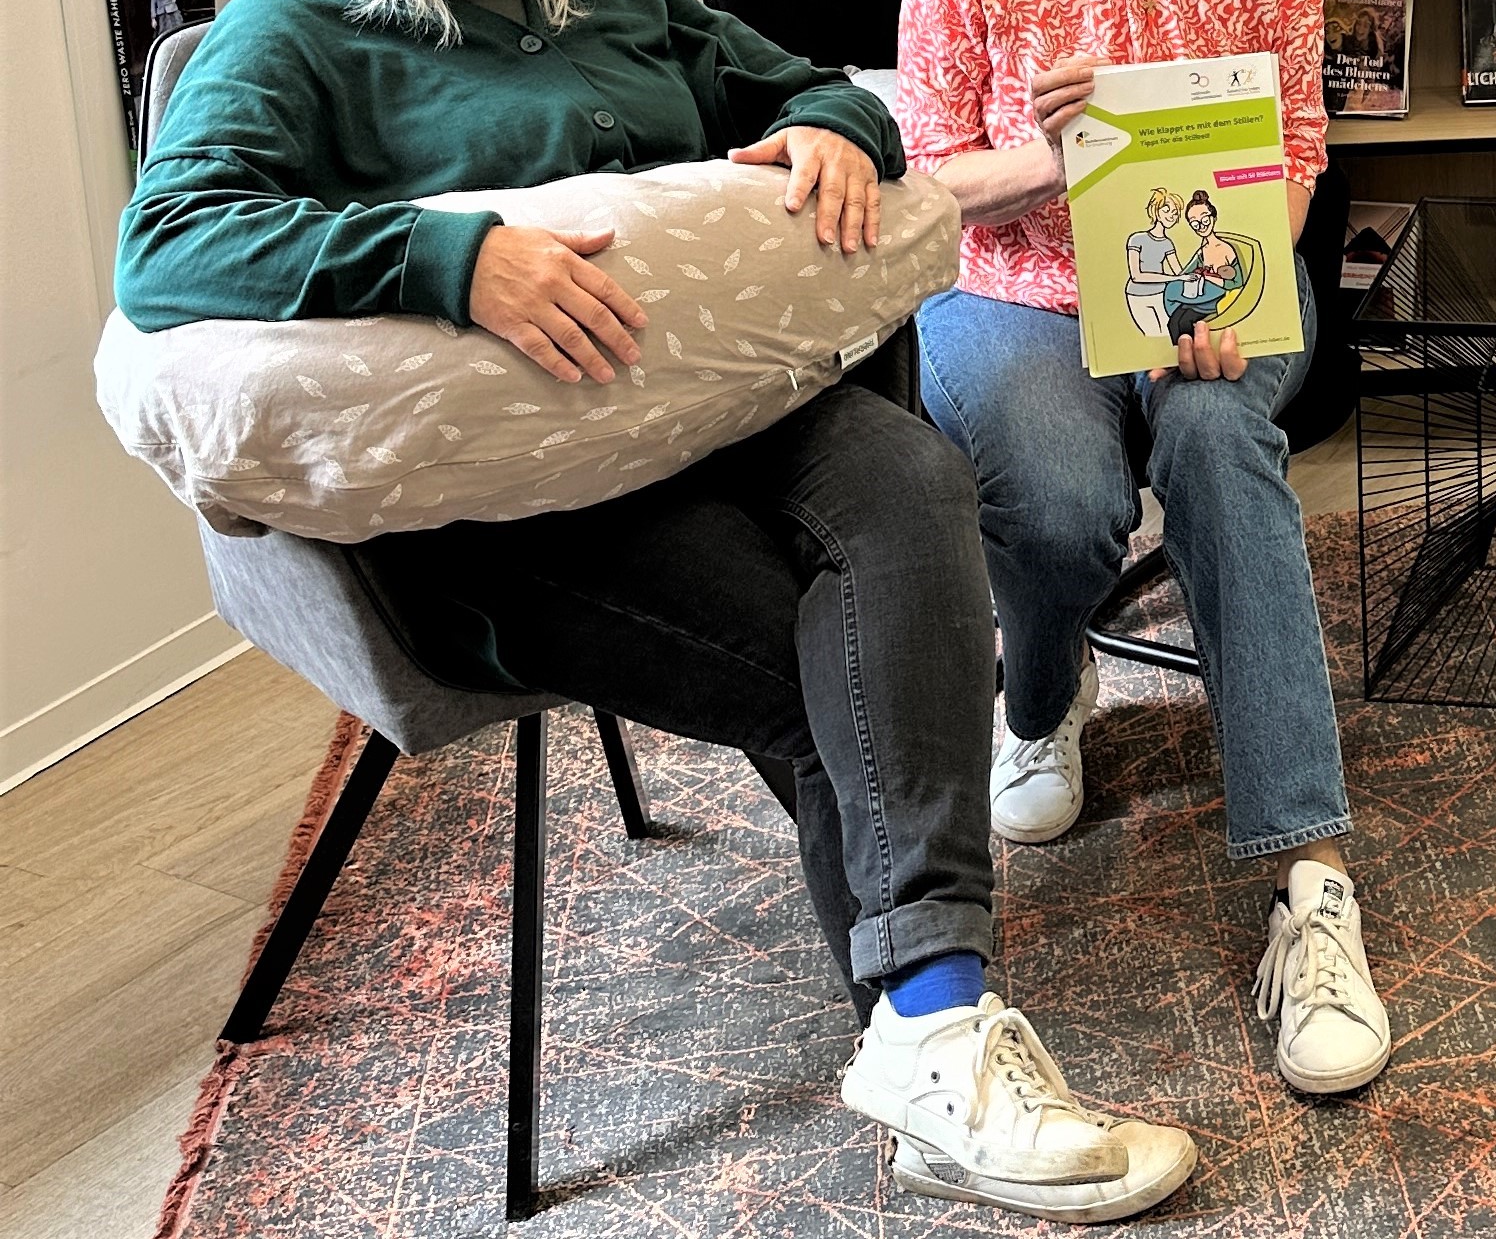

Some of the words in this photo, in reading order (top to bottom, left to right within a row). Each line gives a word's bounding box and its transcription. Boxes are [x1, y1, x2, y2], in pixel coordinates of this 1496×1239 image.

[113, 29, 129, 66] WASTE
[1336, 53, 1360, 66] Der
[1361, 55, 1384, 68] Tod
[1323, 65, 1343, 78] des
[1345, 67, 1390, 81] Blumen
[120, 67, 132, 96] ZERO
[1328, 77, 1389, 93] mädchens
[1138, 128, 1155, 137] Wie
[1156, 125, 1184, 135] klappt
[1197, 122, 1211, 130] mit
[1213, 120, 1231, 128] dem
